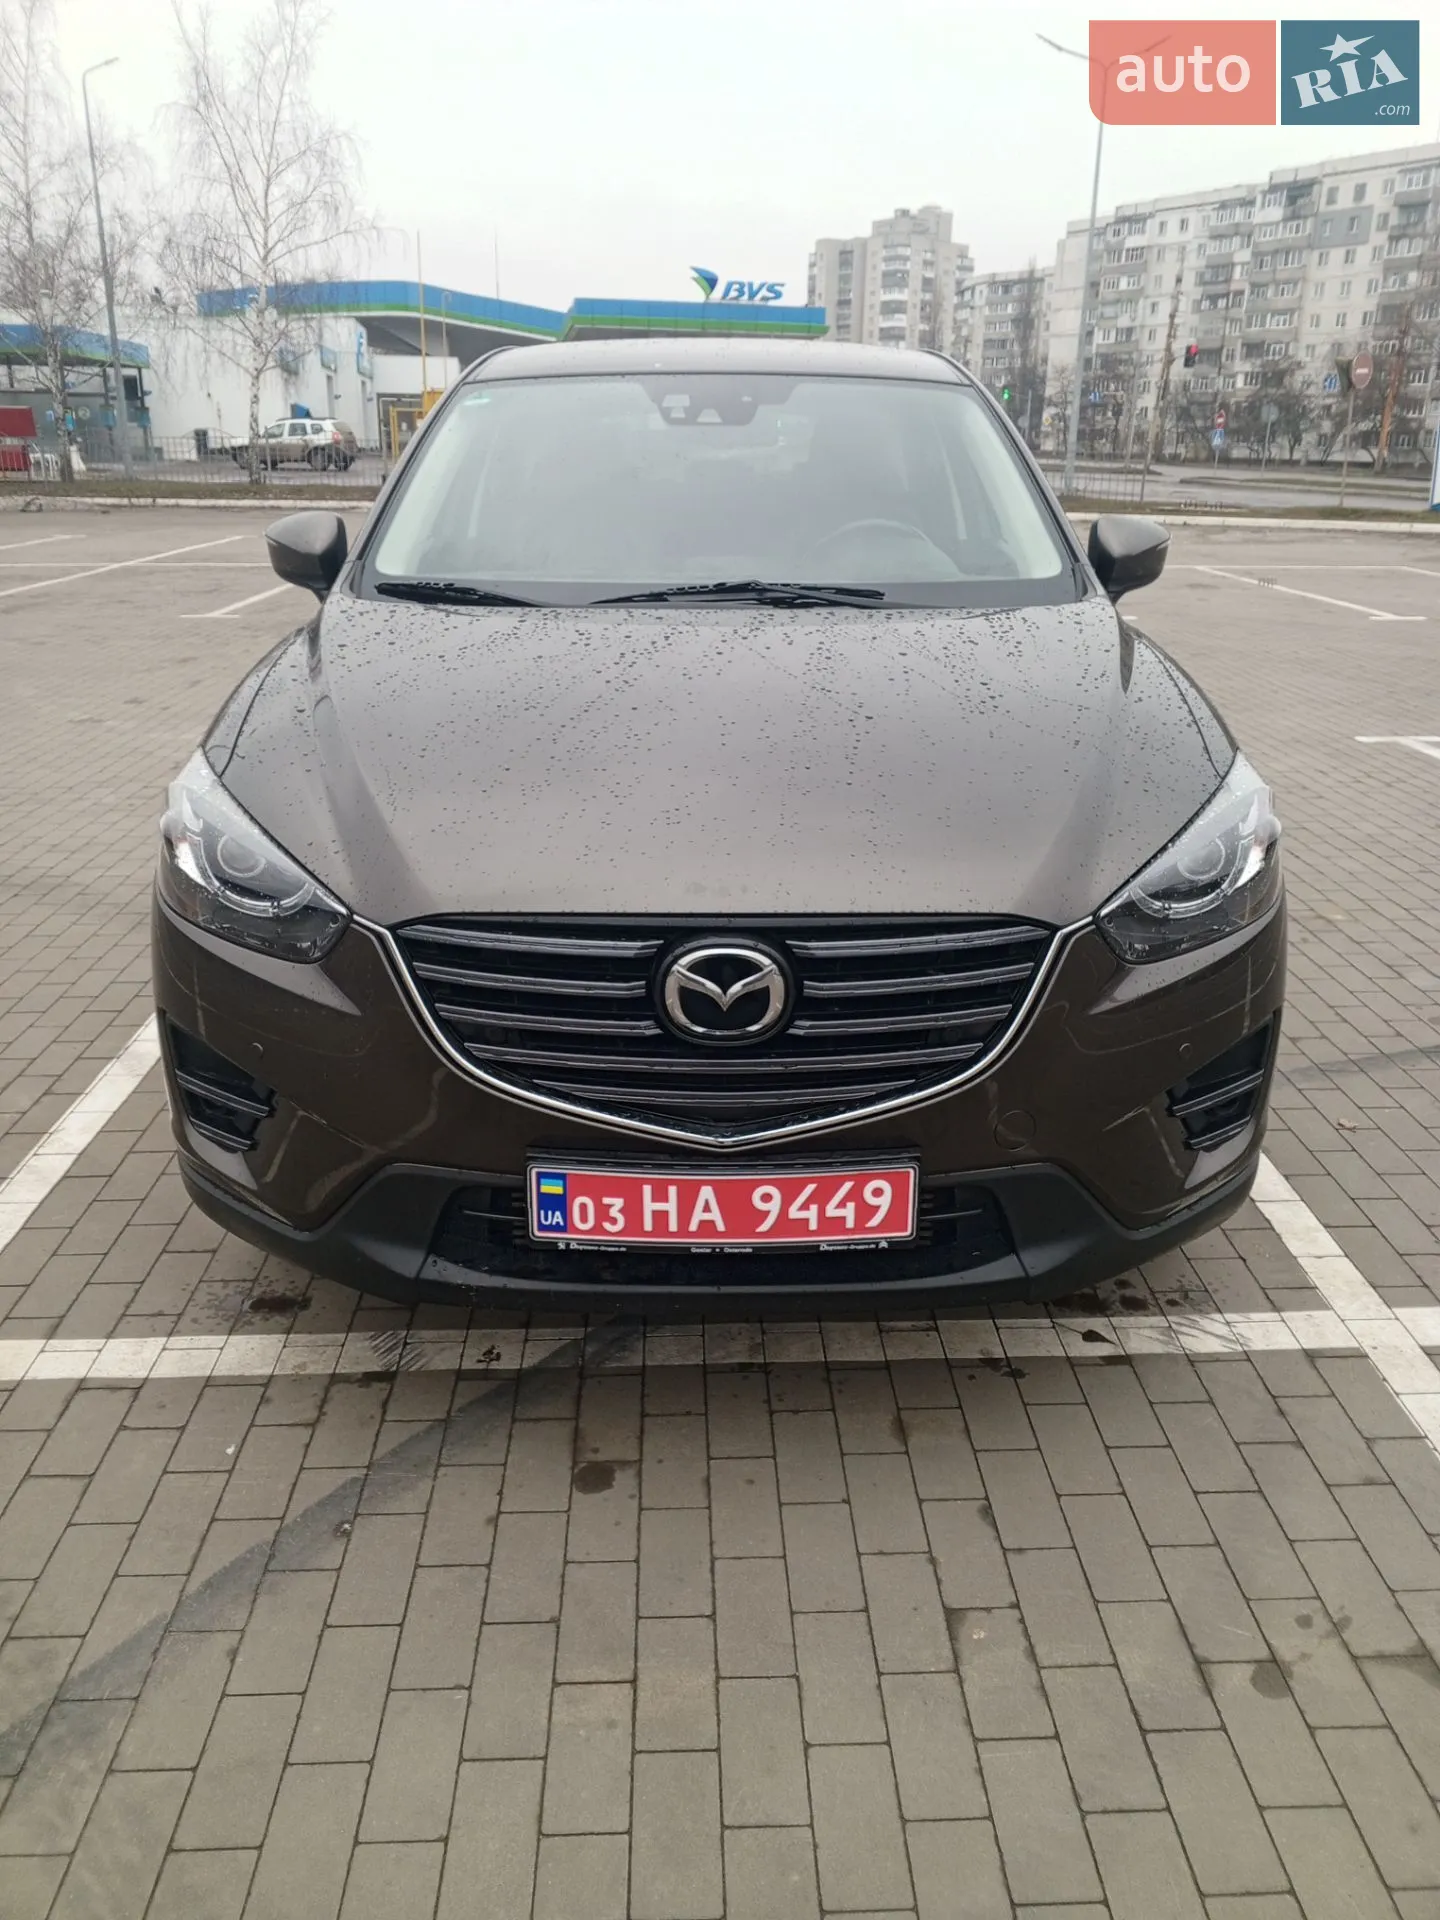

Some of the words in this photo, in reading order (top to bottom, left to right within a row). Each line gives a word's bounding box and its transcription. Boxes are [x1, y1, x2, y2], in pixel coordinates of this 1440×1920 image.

[721, 280, 785, 301] BVS
[572, 1196, 626, 1233] 03
[642, 1184, 726, 1232] HA
[751, 1179, 893, 1233] 9449
[540, 1210, 564, 1227] UA
